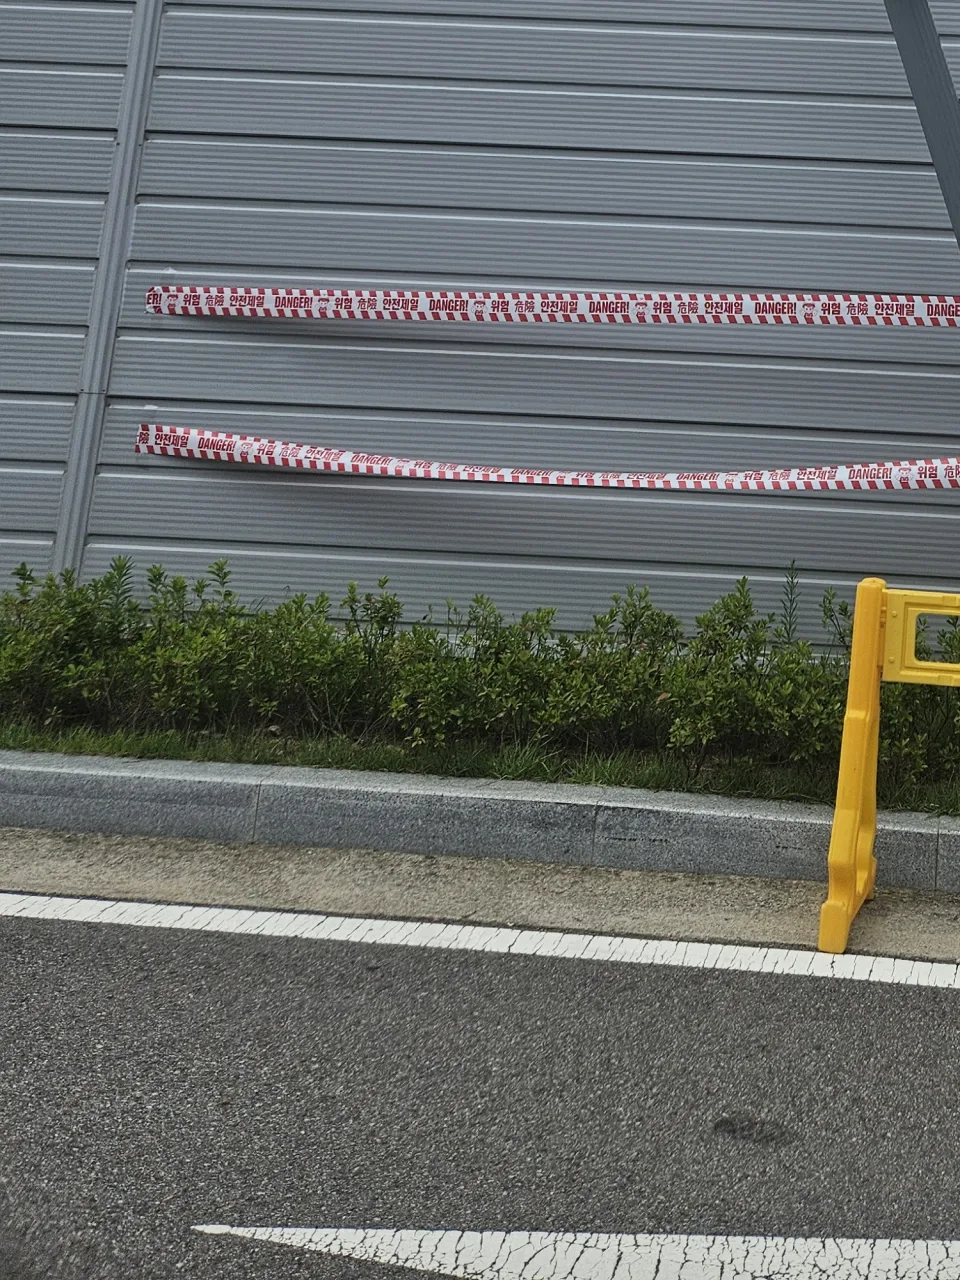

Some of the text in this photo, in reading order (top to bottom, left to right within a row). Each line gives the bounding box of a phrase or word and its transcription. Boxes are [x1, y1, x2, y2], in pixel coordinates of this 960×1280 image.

[183, 294, 200, 306] 위험
[205, 295, 224, 307] 危險
[230, 294, 265, 308] 안전제일
[274, 296, 312, 309] DANGER!
[335, 297, 352, 309] 위험
[357, 297, 377, 310] 危險
[382, 298, 418, 311] 안전제일
[429, 299, 468, 312] DANGER!
[491, 300, 509, 313] 위험
[514, 301, 535, 313] 危險
[540, 300, 578, 314] 안전제일
[589, 301, 630, 314] DANGER!
[653, 301, 672, 314] 위험
[677, 302, 699, 314] 危險
[704, 301, 743, 315] 안전제일
[754, 302, 797, 315] DANGER!
[821, 302, 841, 315] 위험
[846, 303, 869, 316] 危險
[874, 303, 915, 316] 안전제일
[154, 433, 189, 448] 안전제일
[198, 436, 237, 452] DANGER!
[257, 443, 274, 456] 위험
[278, 446, 299, 458] 危險
[304, 448, 344, 462] 안전제일
[350, 454, 393, 466] DANGER!
[510, 468, 553, 477] DANGER!
[676, 472, 720, 481] DANGER!
[743, 472, 762, 481] 위험
[768, 471, 790, 481] 危險
[796, 469, 837, 481] 안전제일
[848, 467, 892, 480] DANGER!
[917, 465, 938, 479] 위험
